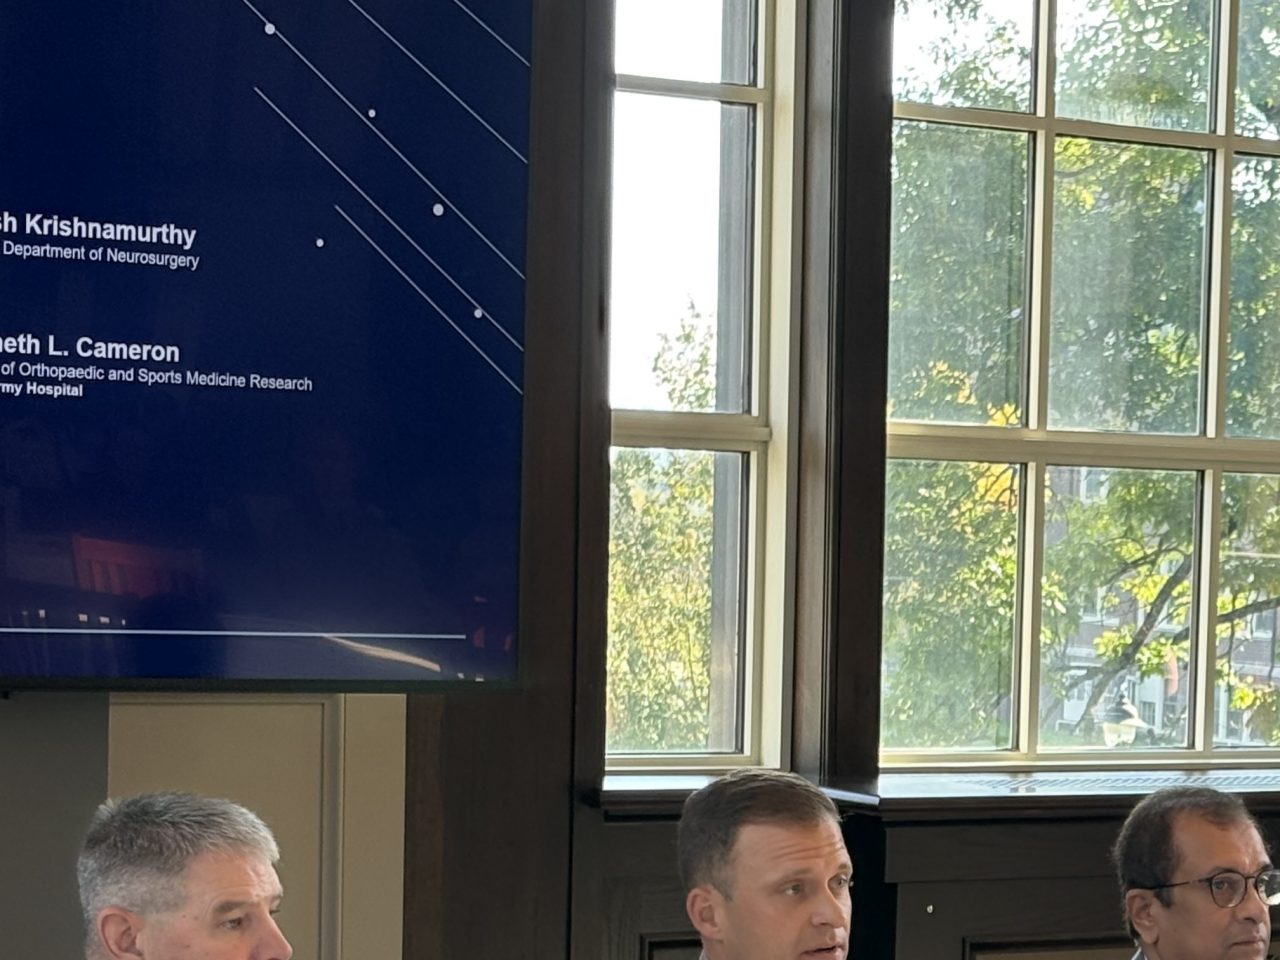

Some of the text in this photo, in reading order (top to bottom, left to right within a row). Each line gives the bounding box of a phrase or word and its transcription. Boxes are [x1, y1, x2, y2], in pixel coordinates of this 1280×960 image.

[0, 211, 197, 250] h Krishnamurthy
[3, 240, 200, 271] Department of Neurosurgery
[0, 333, 180, 363] eth L. Cameron
[0, 381, 83, 398] my Hospital
[1, 361, 313, 391] of Orthopaedic and Sports Medicine Research
